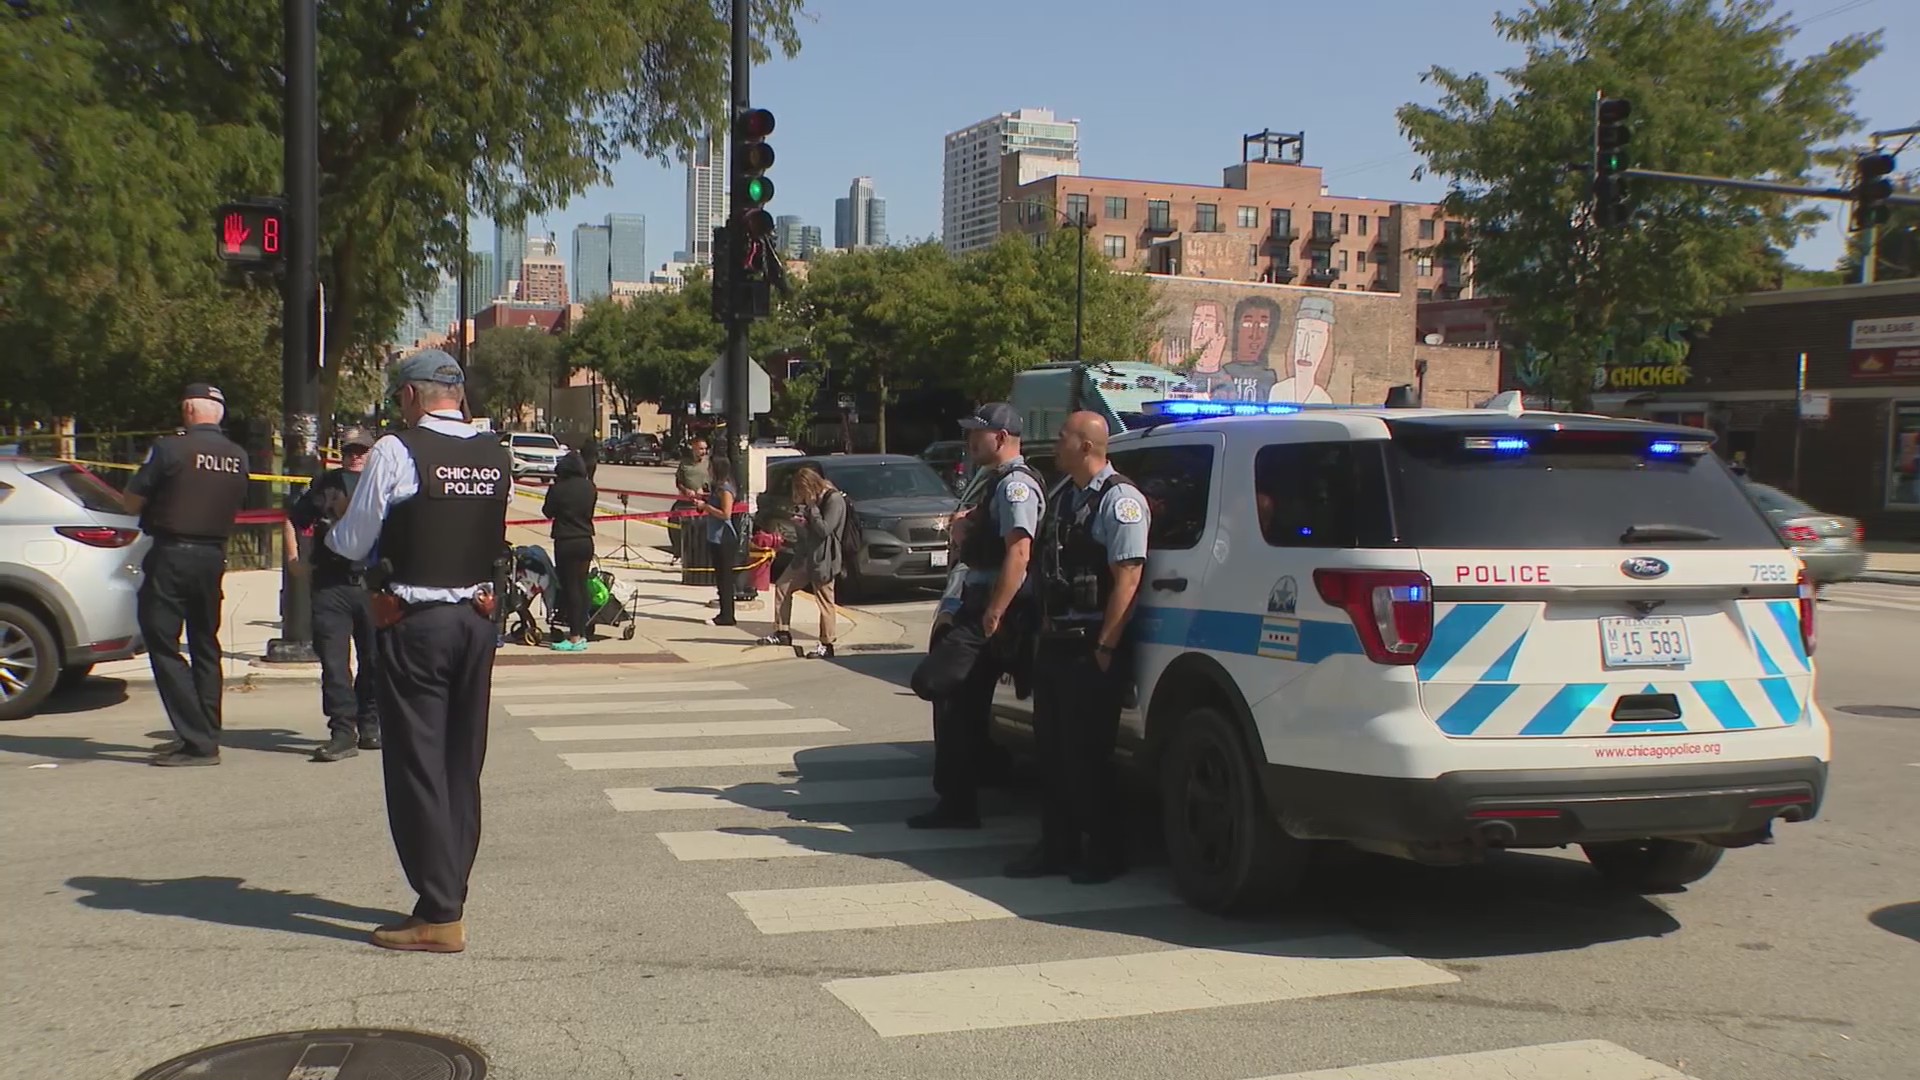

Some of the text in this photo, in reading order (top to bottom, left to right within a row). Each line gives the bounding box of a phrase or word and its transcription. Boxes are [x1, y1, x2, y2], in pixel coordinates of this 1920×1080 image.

[264, 218, 278, 252] 8
[1856, 322, 1914, 335] FOR LEASE
[196, 454, 240, 473] POLICE
[436, 466, 501, 481] CHICAGO
[444, 482, 495, 495] POLICE
[1456, 565, 1551, 583] POLICE
[1750, 565, 1787, 581] 7252
[1622, 631, 1682, 655] 15 583
[1594, 743, 1721, 759] www.chicagopolice.org
